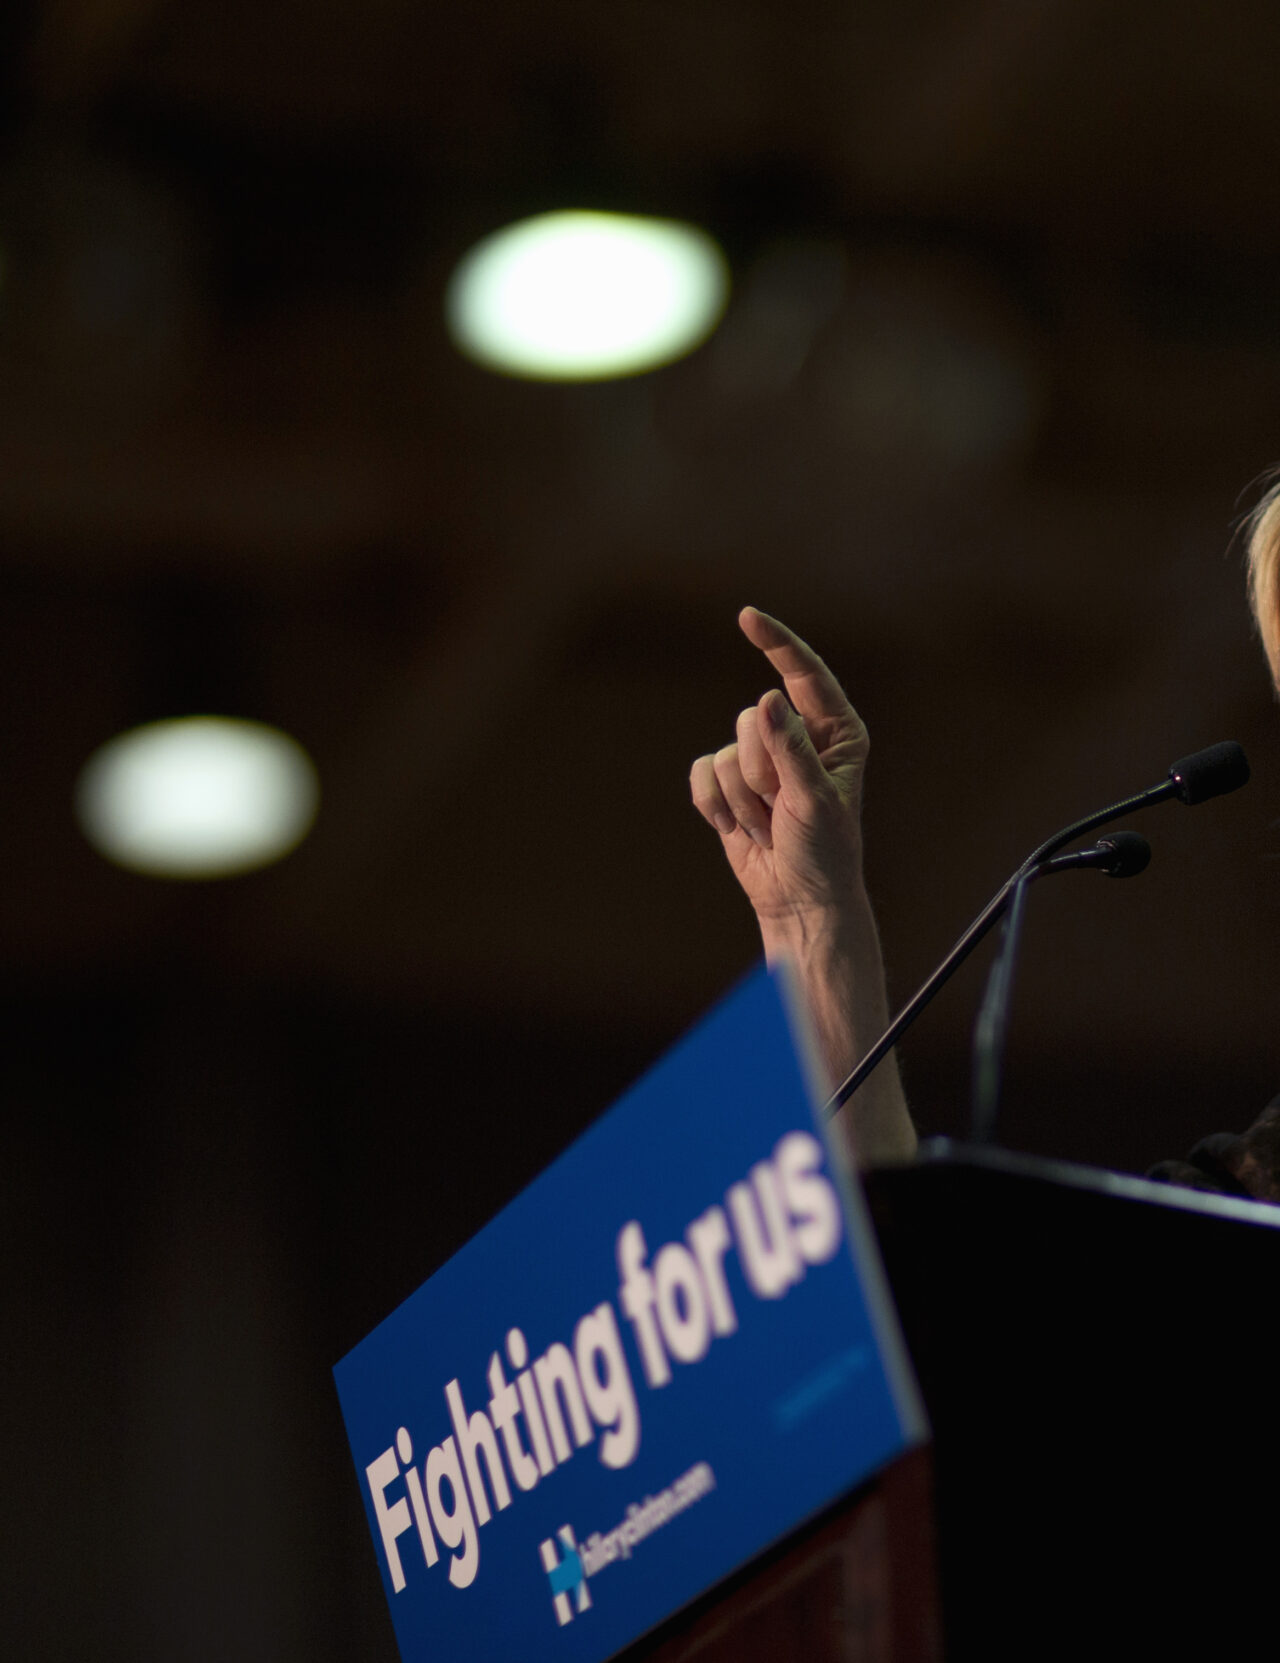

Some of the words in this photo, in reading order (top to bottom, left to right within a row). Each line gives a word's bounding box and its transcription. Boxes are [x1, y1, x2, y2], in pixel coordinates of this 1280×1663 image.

[365, 1301, 640, 1595] Fighting
[617, 1205, 738, 1389] for
[726, 1129, 842, 1299] us
